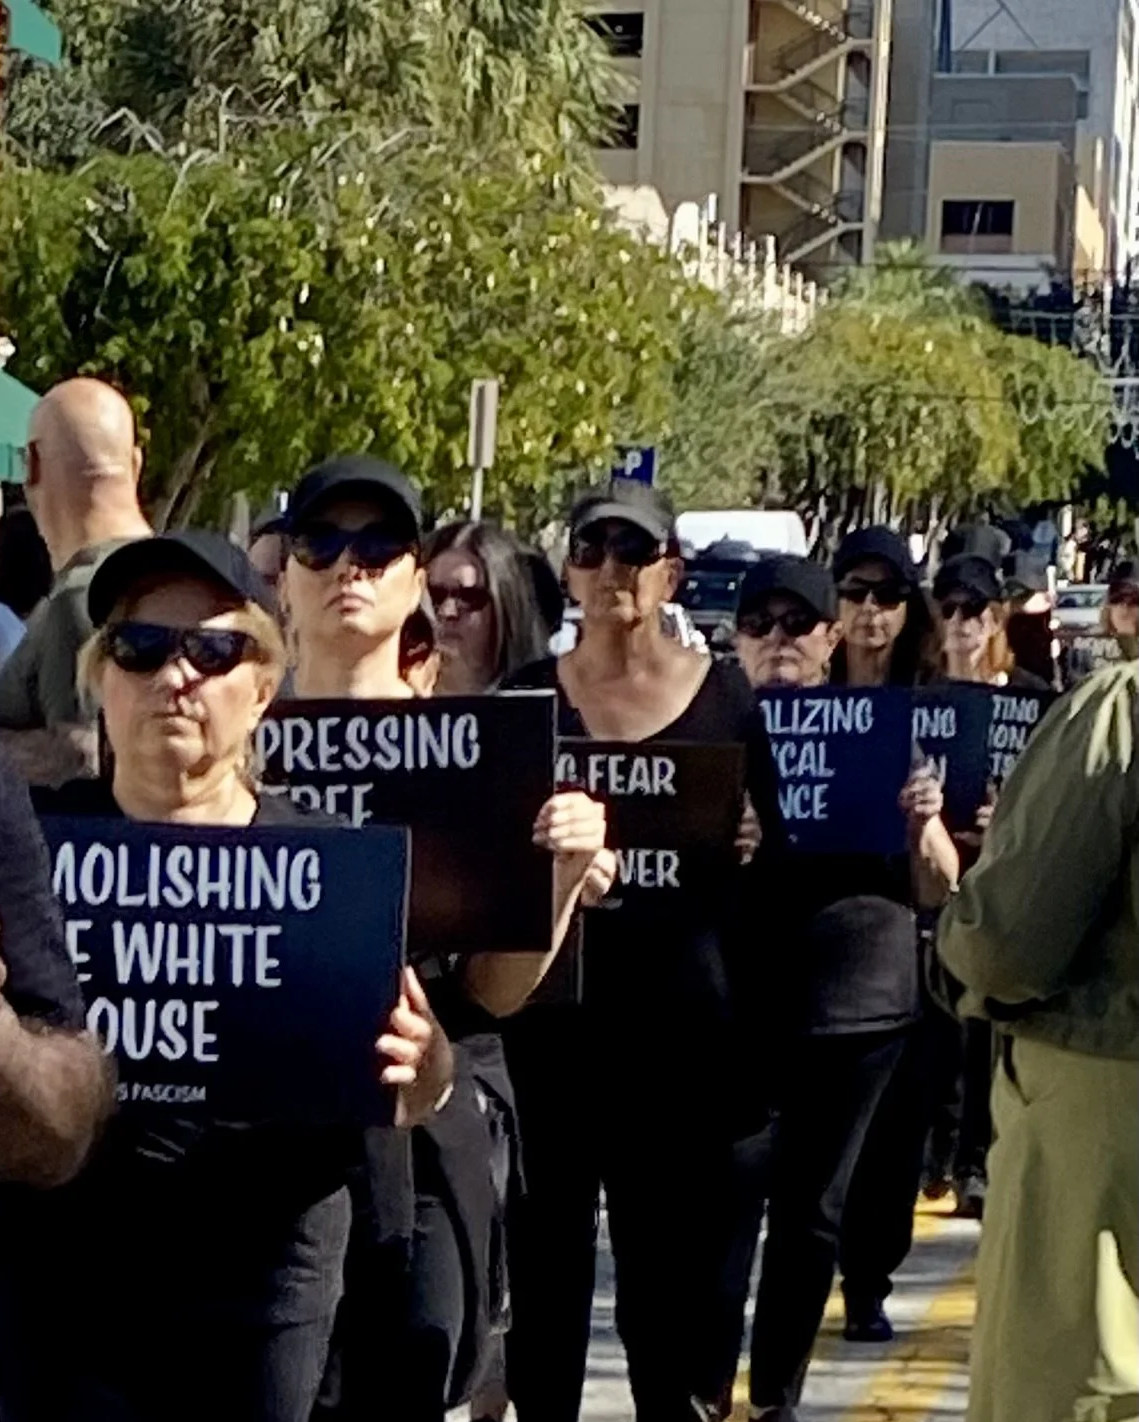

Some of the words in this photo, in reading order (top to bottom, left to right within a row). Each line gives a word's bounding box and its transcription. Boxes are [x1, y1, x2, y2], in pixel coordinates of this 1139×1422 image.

[624, 450, 643, 476] P
[255, 712, 481, 773] PRESSING
[588, 753, 678, 797] FEAR
[112, 920, 282, 988] WHITE
